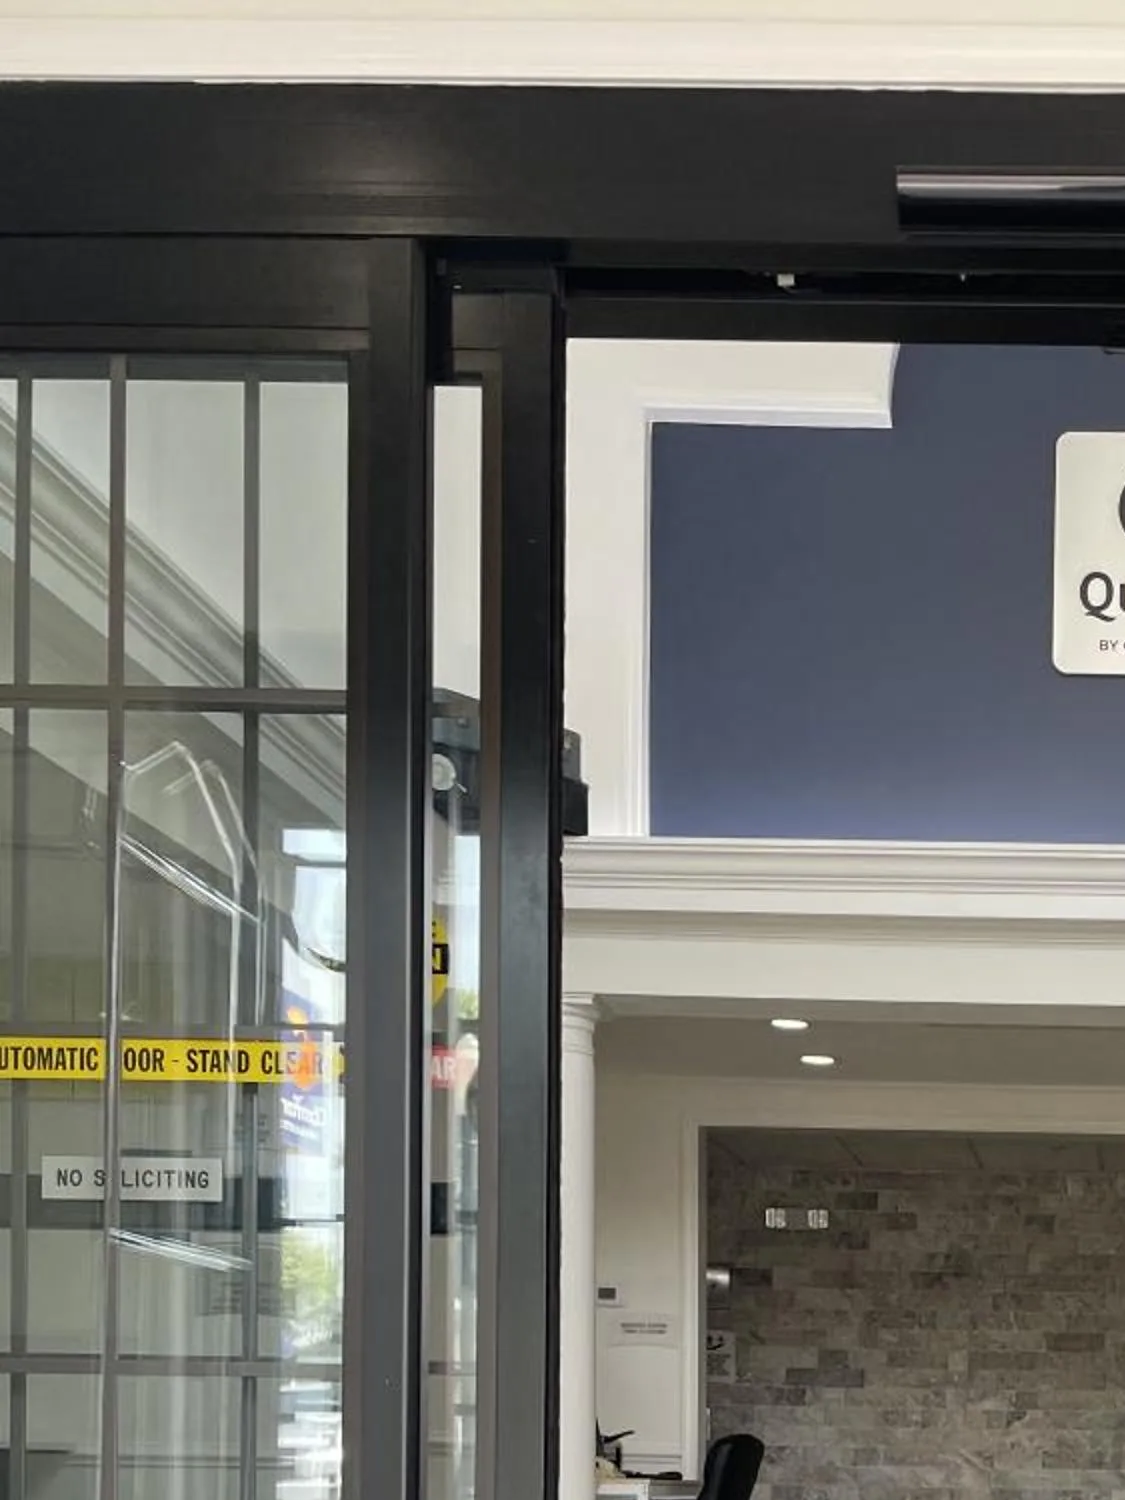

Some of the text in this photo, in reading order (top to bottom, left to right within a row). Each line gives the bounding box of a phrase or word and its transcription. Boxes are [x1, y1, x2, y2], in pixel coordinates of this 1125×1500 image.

[1099, 639, 1119, 652] BY
[0, 1046, 99, 1071] UTOMATIC
[123, 1048, 165, 1072] OOR
[186, 1049, 250, 1074] STAND
[57, 1168, 209, 1189] NO SLICITING
